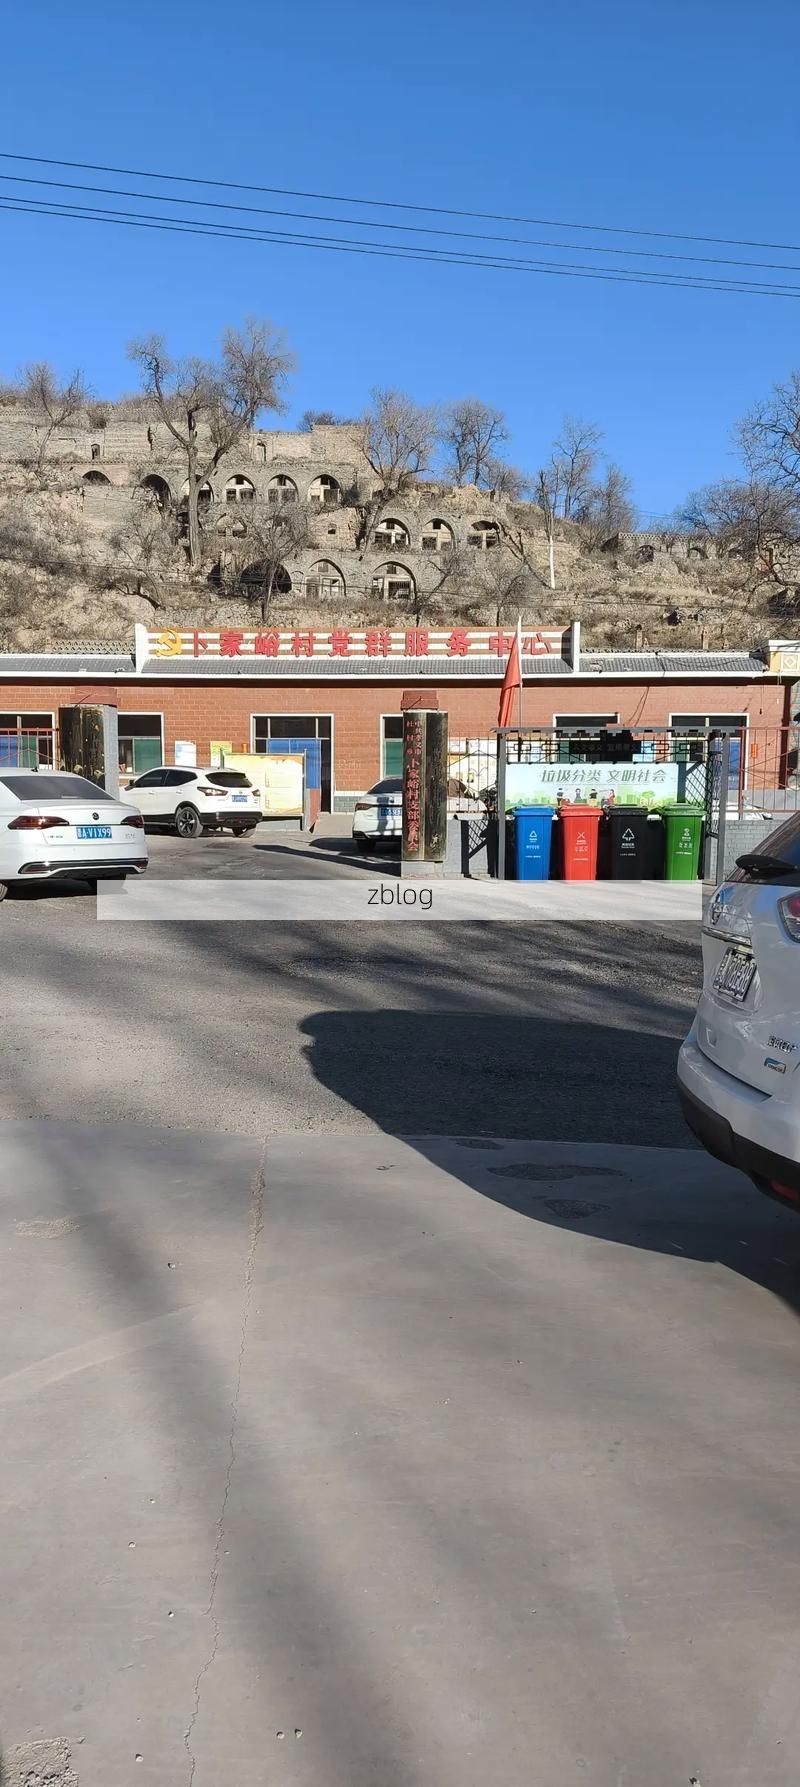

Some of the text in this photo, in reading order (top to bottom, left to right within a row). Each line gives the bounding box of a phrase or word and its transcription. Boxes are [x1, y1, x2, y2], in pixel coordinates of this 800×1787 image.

[193, 628, 552, 658] 卜家峪村党群服务中心
[540, 768, 667, 783] 垃圾分类 文明社会
